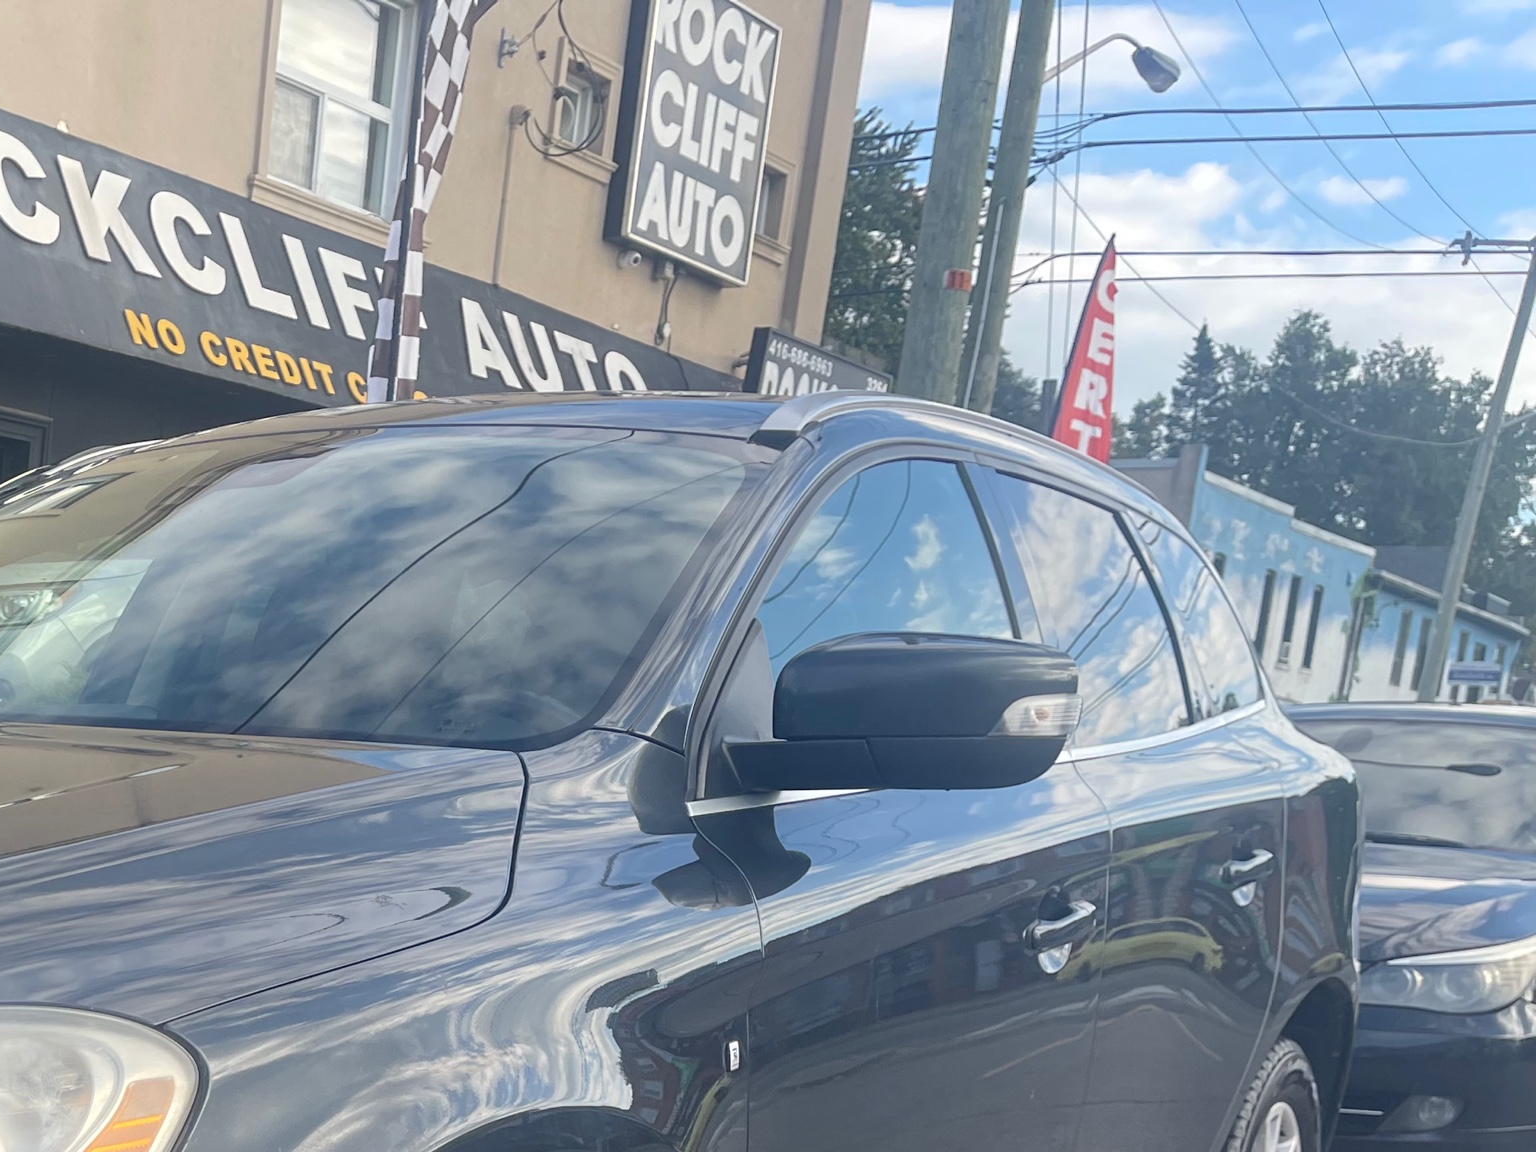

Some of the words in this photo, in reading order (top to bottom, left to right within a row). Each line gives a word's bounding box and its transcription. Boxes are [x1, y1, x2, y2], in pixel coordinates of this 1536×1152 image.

[655, 0, 775, 103] ROCK
[651, 69, 760, 183] CLIFF
[636, 161, 745, 268] AUTO
[124, 309, 186, 354] NO
[200, 330, 335, 395] CREDIT
